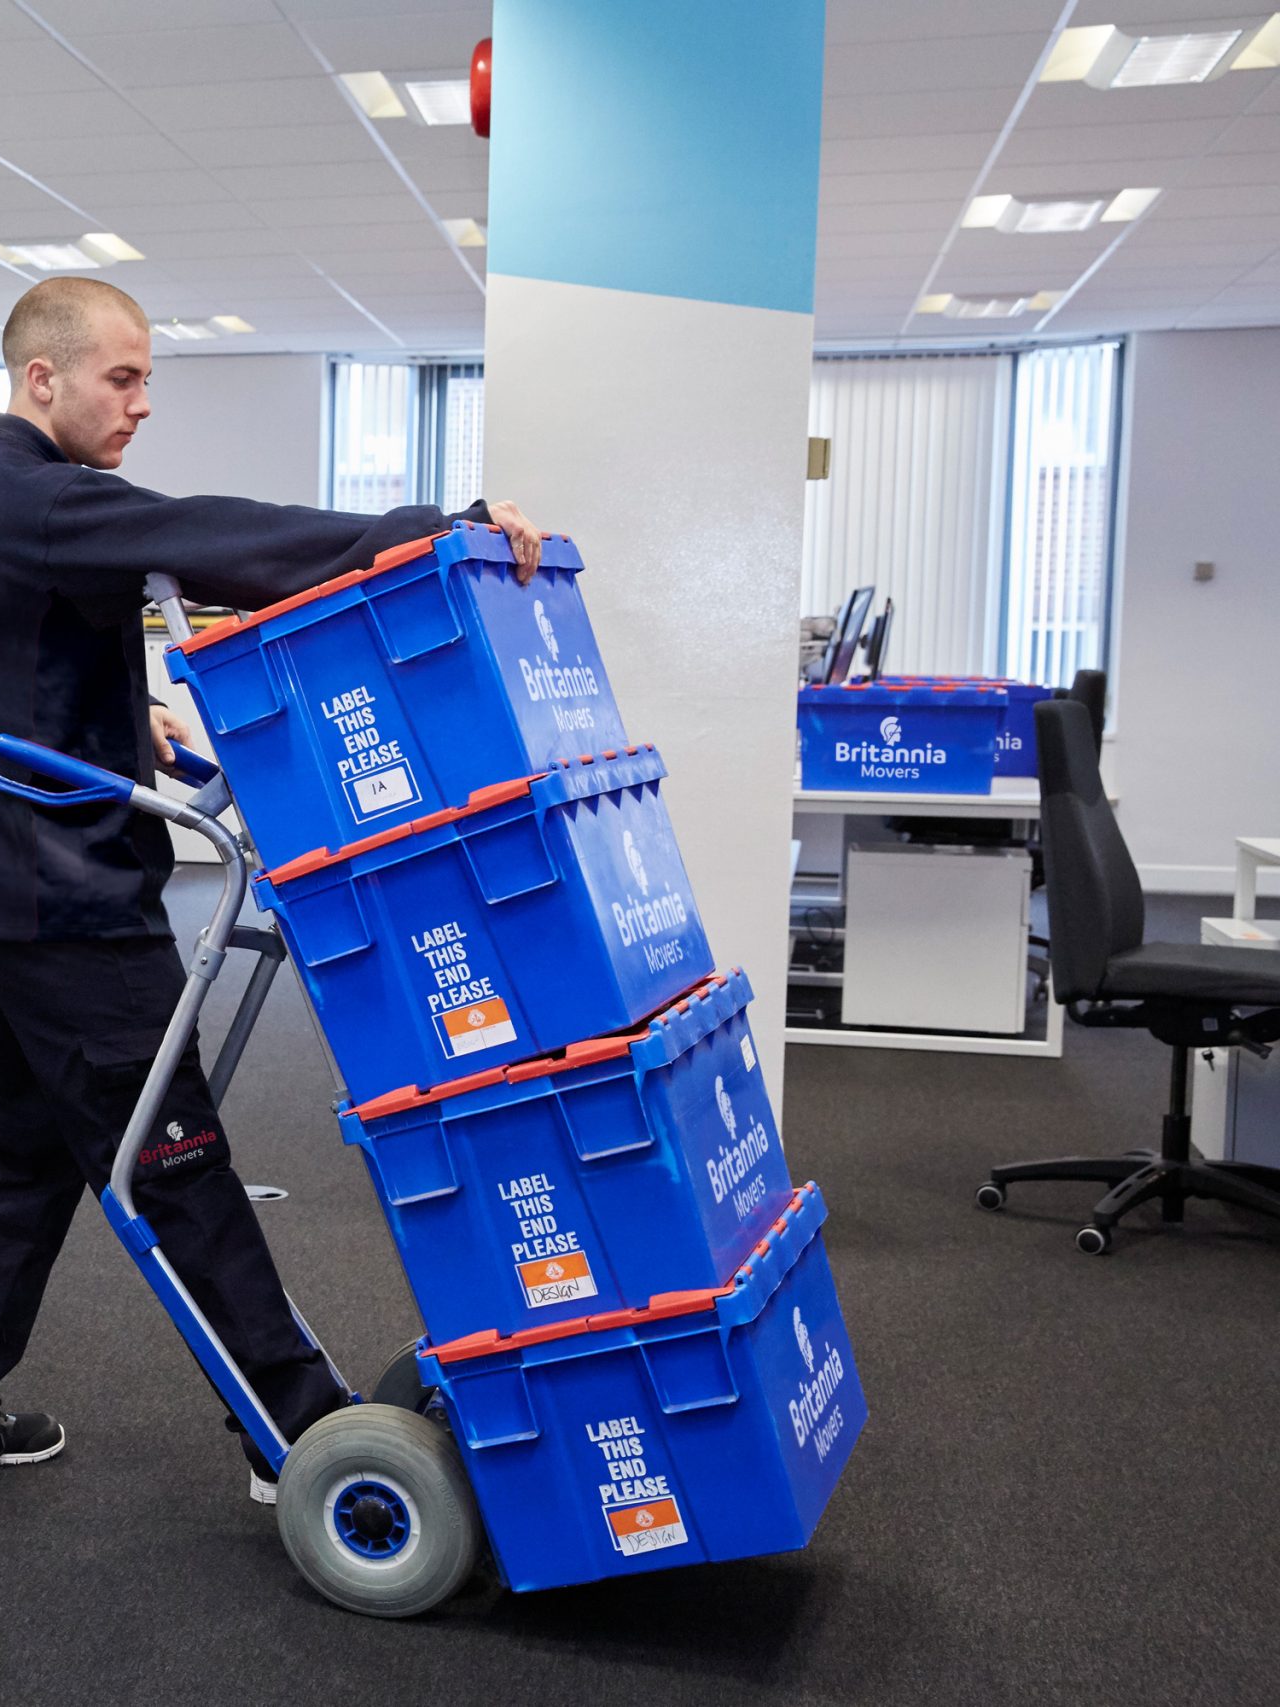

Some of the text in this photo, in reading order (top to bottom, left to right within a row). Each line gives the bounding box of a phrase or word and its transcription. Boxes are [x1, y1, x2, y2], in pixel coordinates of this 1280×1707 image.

[518, 653, 599, 702] Britannia
[320, 685, 376, 719] LABEL
[333, 706, 376, 735] THIS
[552, 704, 594, 733] Movers
[343, 727, 380, 755] END
[835, 741, 947, 764] Britannia
[337, 740, 403, 779] PLEASE
[861, 764, 920, 779] Movers
[611, 880, 687, 948] Britannia
[410, 921, 467, 953] LABEL
[423, 942, 467, 970] THIS
[643, 938, 684, 975] Movers
[434, 962, 471, 989] END
[427, 976, 494, 1013] PLEASE
[138, 1130, 217, 1165] Britannia
[162, 1147, 204, 1169] Movers
[706, 1113, 769, 1204] Britannia
[497, 1173, 555, 1201] LABEL
[732, 1173, 766, 1223] Movers
[510, 1194, 554, 1219] THIS
[519, 1215, 558, 1239] END
[511, 1231, 580, 1262] PLEASE
[531, 1277, 580, 1304] DESIGN
[788, 1341, 844, 1448] Britannia
[585, 1416, 645, 1443] LABEL
[813, 1404, 844, 1464] Movers
[598, 1436, 644, 1461] THIS
[607, 1458, 647, 1481] END
[598, 1475, 670, 1504] PLEASE
[625, 1525, 676, 1553] DESIGN
